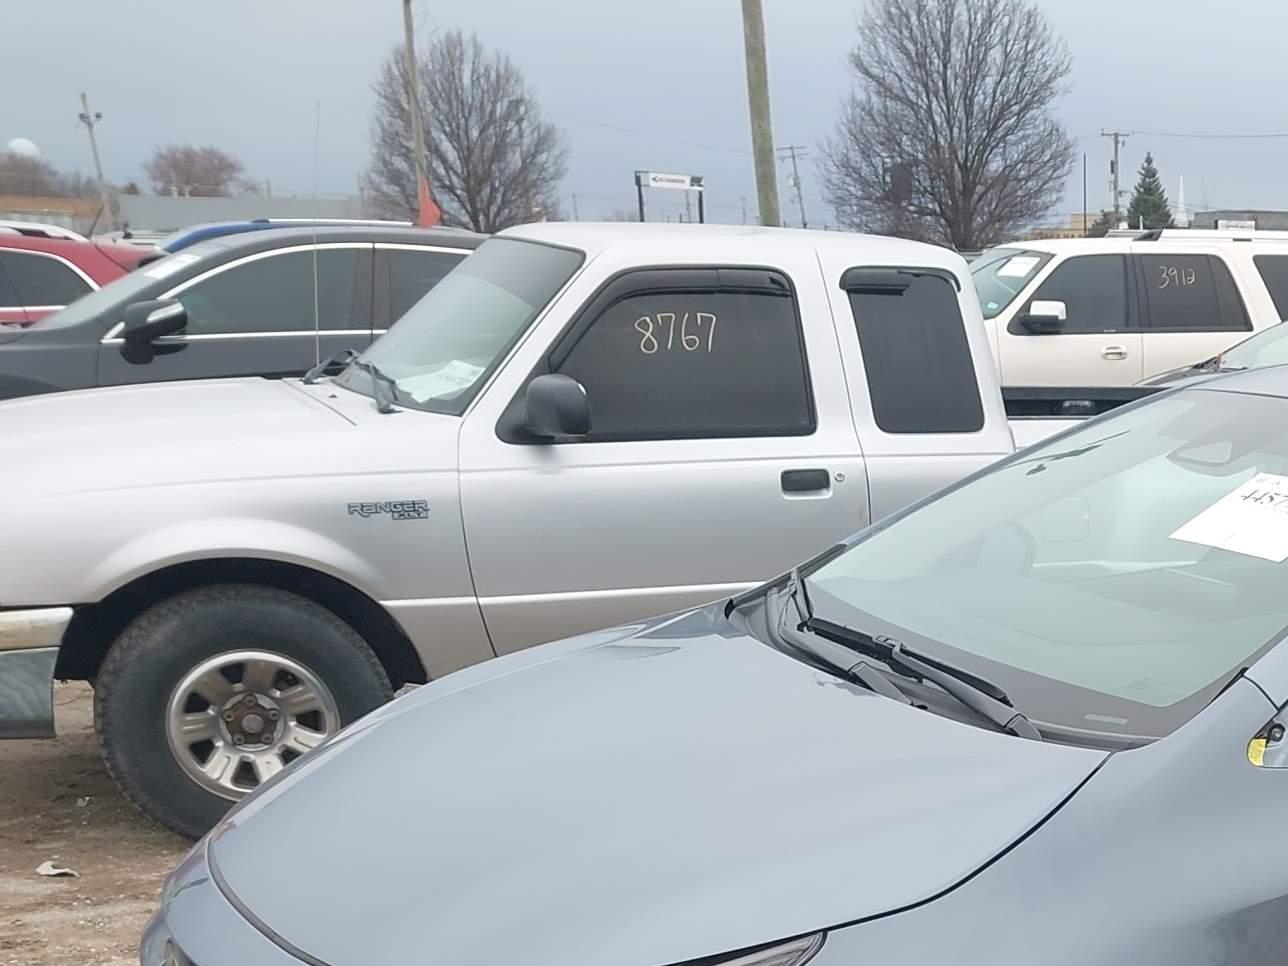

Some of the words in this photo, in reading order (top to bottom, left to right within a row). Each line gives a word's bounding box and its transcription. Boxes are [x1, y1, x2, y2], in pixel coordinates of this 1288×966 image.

[1159, 265, 1195, 288] 3912
[634, 312, 717, 353] 8767
[347, 500, 430, 518] RANGER
